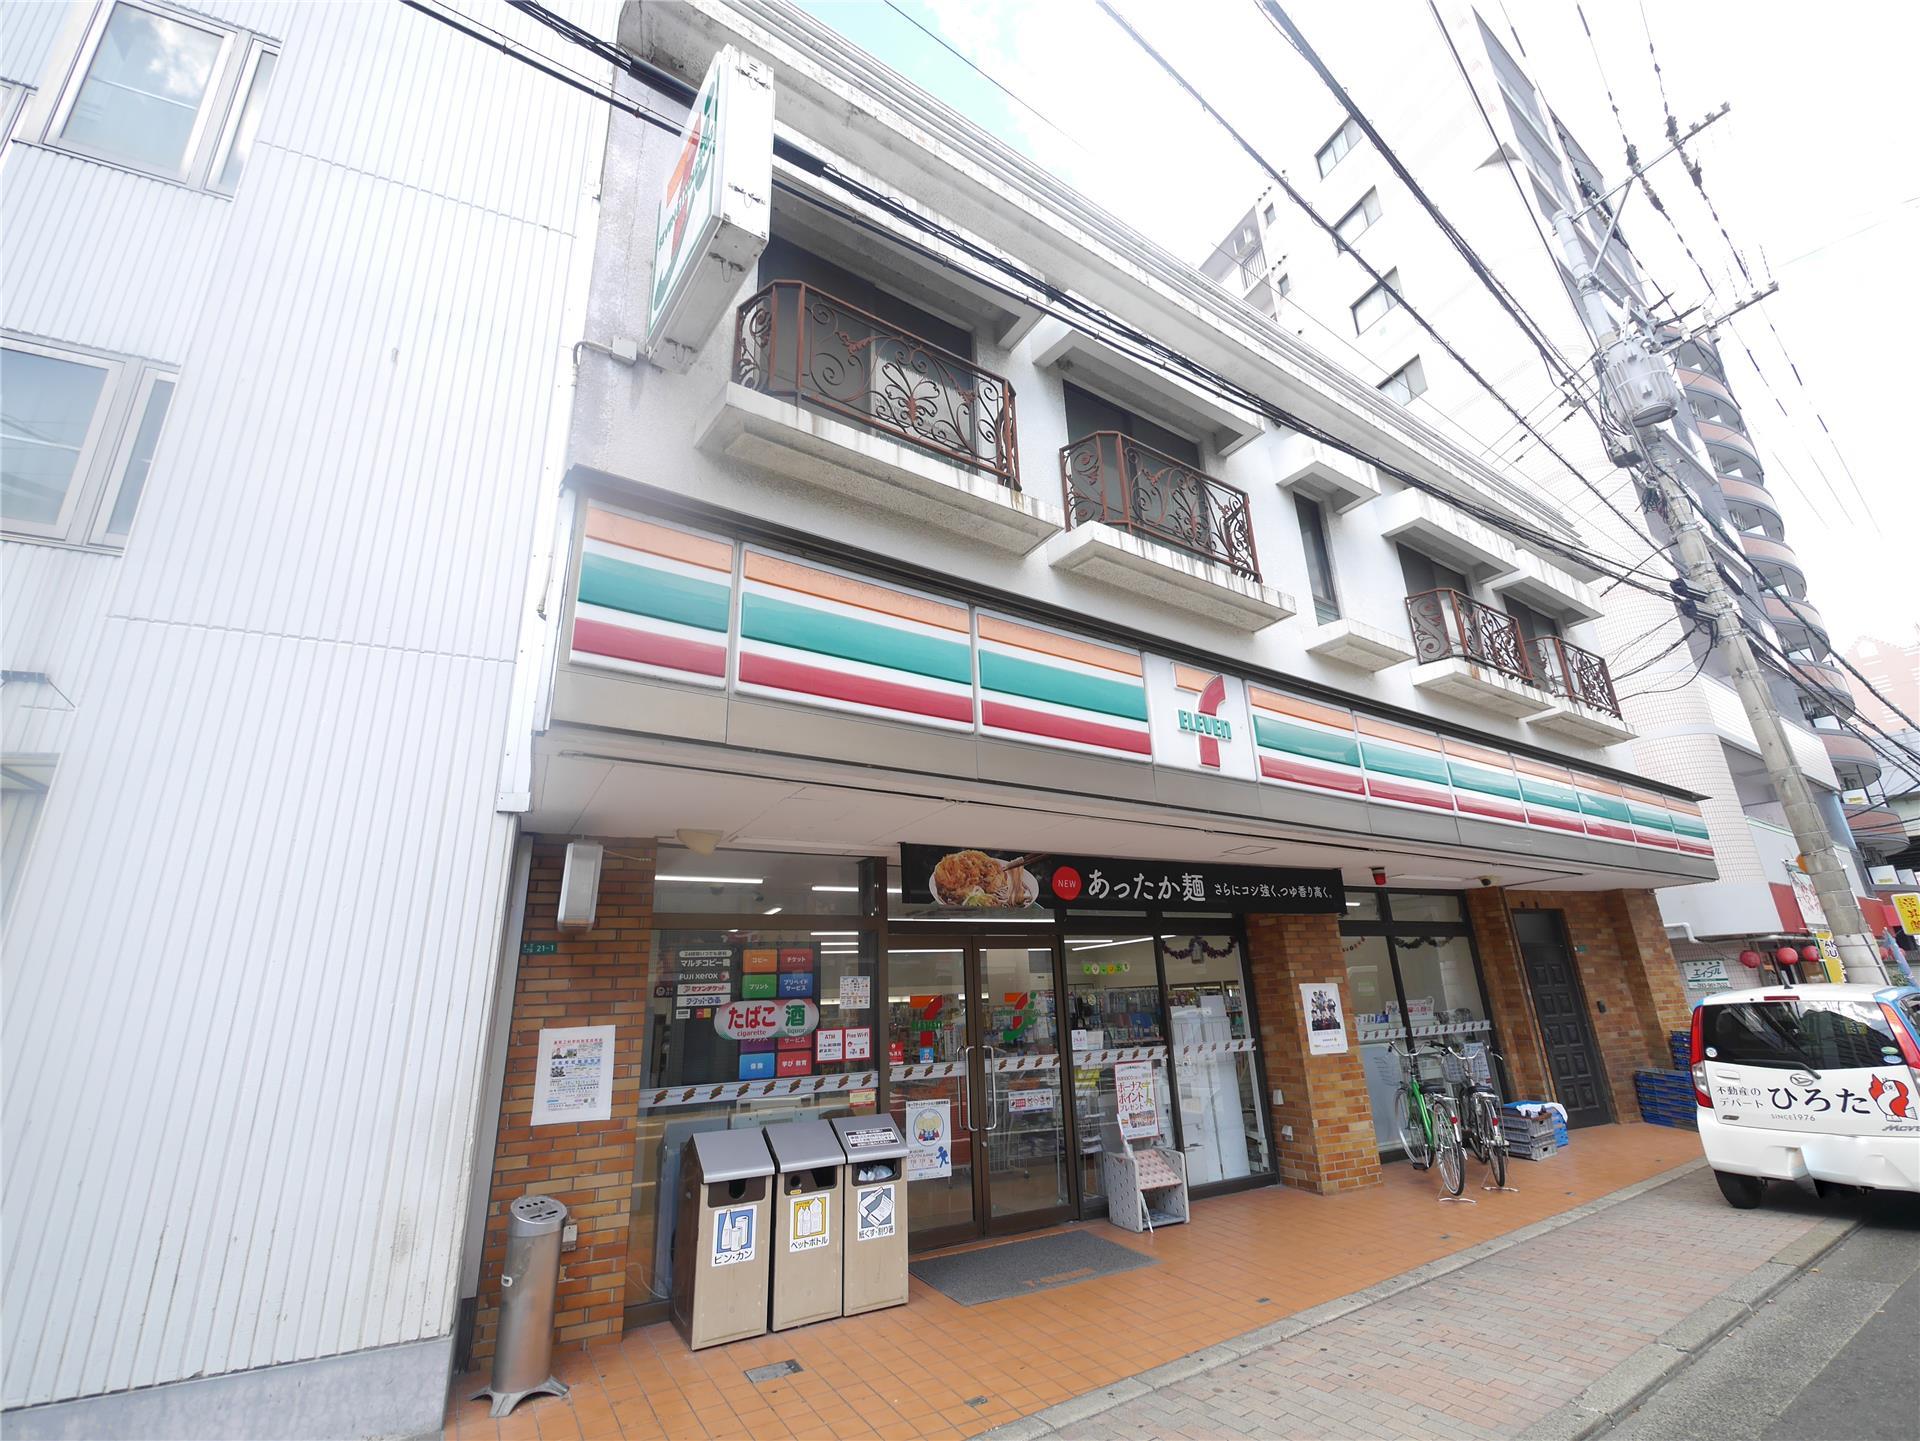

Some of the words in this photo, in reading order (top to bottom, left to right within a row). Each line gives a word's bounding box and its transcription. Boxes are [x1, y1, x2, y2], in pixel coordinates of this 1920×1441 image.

[1057, 879, 1077, 889] NEW
[1088, 869, 1206, 902] あったか麺
[728, 1006, 776, 1029] たばこ
[785, 1004, 805, 1026] 酒
[736, 1029, 767, 1037] cigarette
[1118, 1081, 1143, 1093] ボーナス
[1717, 1086, 1761, 1096] 不動産の
[1118, 1092, 1144, 1104] ポイント
[1719, 1098, 1763, 1109] デパート
[1767, 1087, 1871, 1114] ひろた
[790, 1237, 828, 1249] ペットボトル
